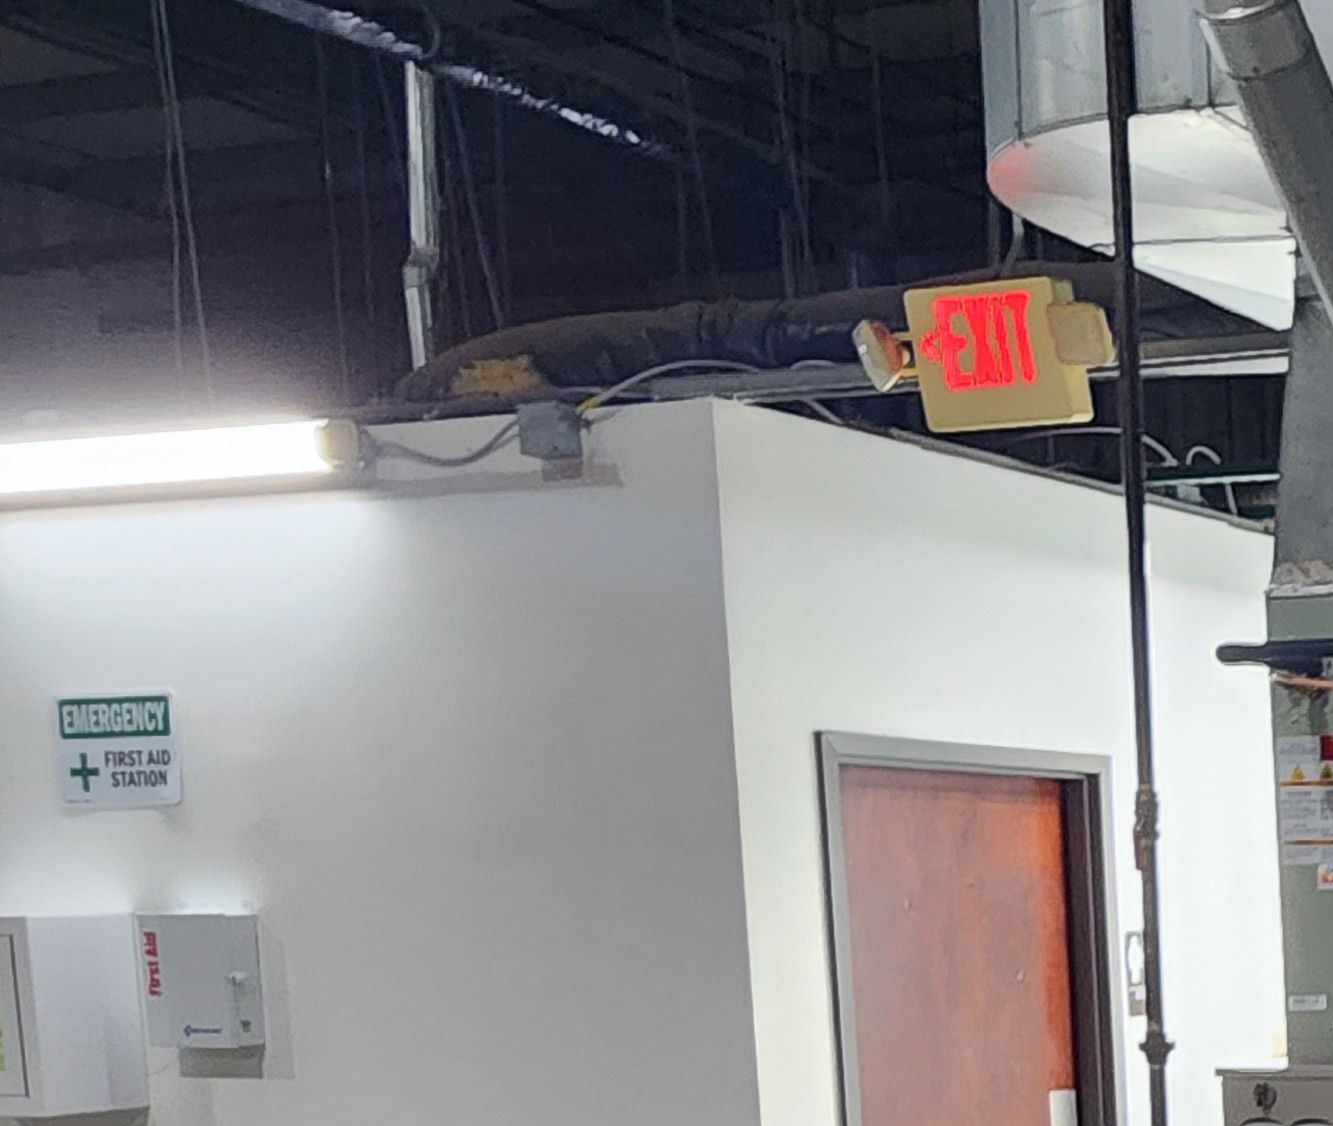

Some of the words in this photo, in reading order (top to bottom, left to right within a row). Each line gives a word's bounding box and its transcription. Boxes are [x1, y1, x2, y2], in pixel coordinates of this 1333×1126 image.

[932, 289, 1036, 391] EXIT
[61, 701, 165, 734] EMERGENCY
[104, 750, 143, 767] FIRST
[147, 749, 171, 766] AID
[110, 769, 168, 788] STATION
[143, 931, 158, 957] Aid
[147, 961, 162, 996] First
